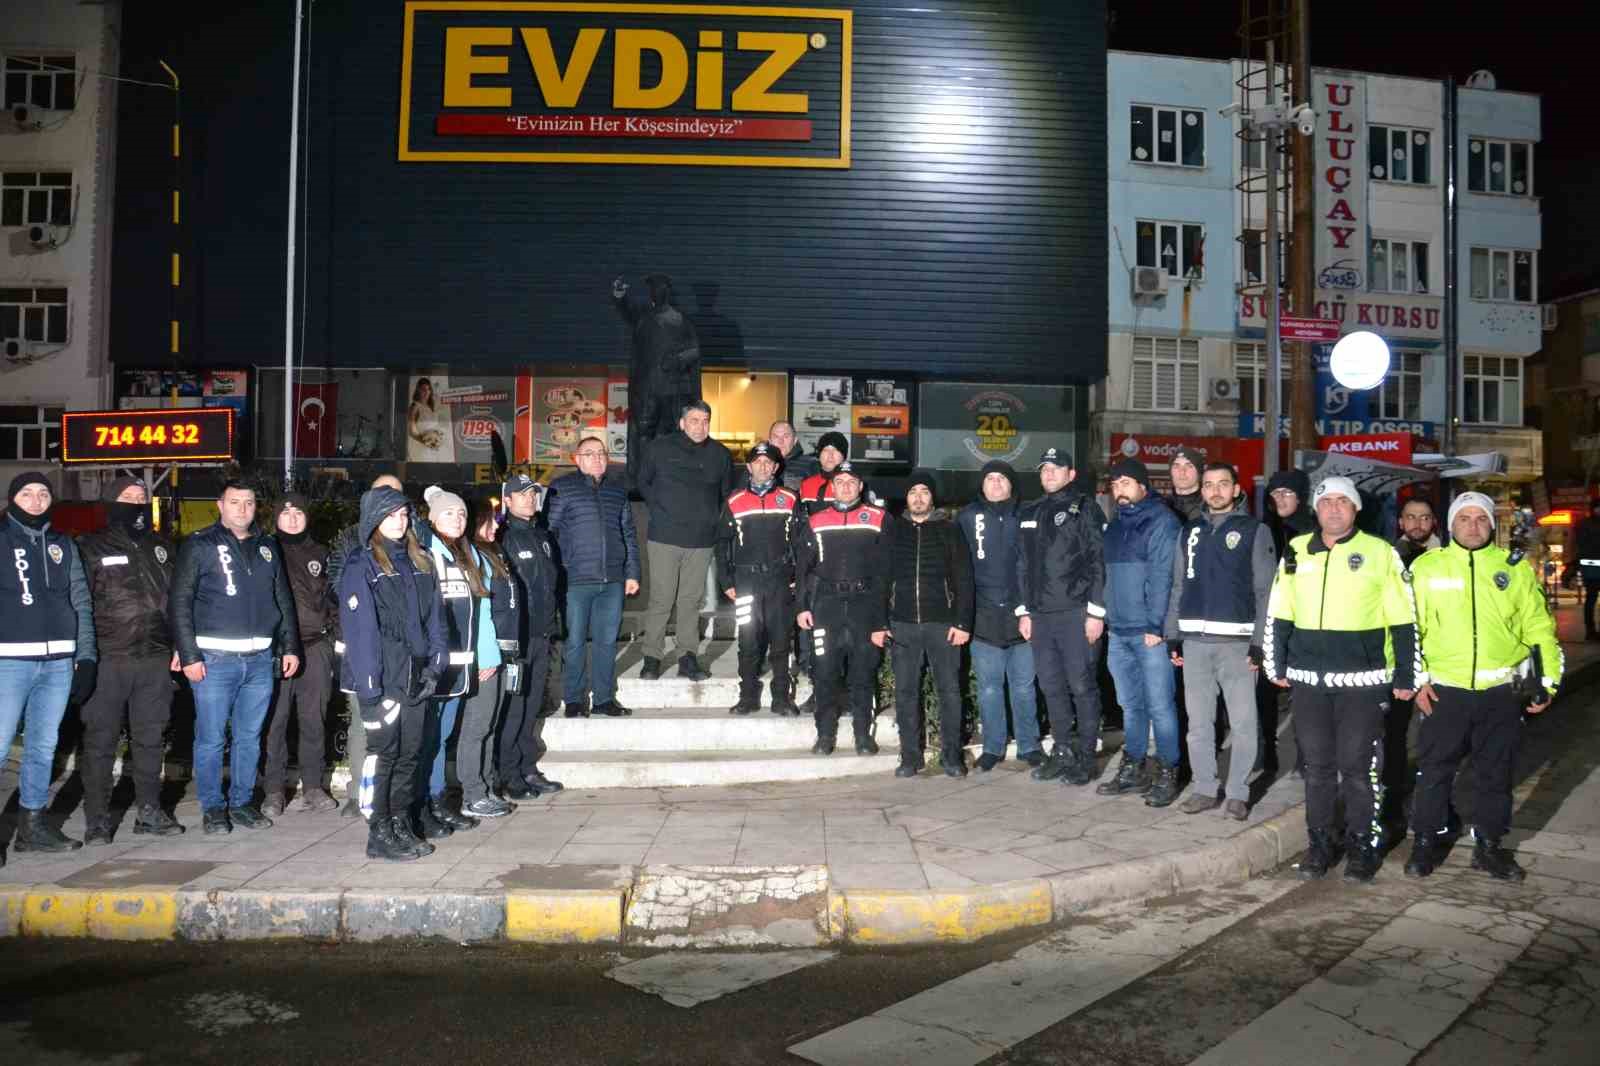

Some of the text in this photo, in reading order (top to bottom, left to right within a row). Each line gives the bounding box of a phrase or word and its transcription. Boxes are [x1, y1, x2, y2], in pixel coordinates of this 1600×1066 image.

[589, 117, 620, 132] Her
[1326, 84, 1356, 249] ULUÇAY
[1357, 303, 1440, 330] KURSU
[95, 424, 199, 446] 714 44 32
[1328, 440, 1400, 452] AKBANK
